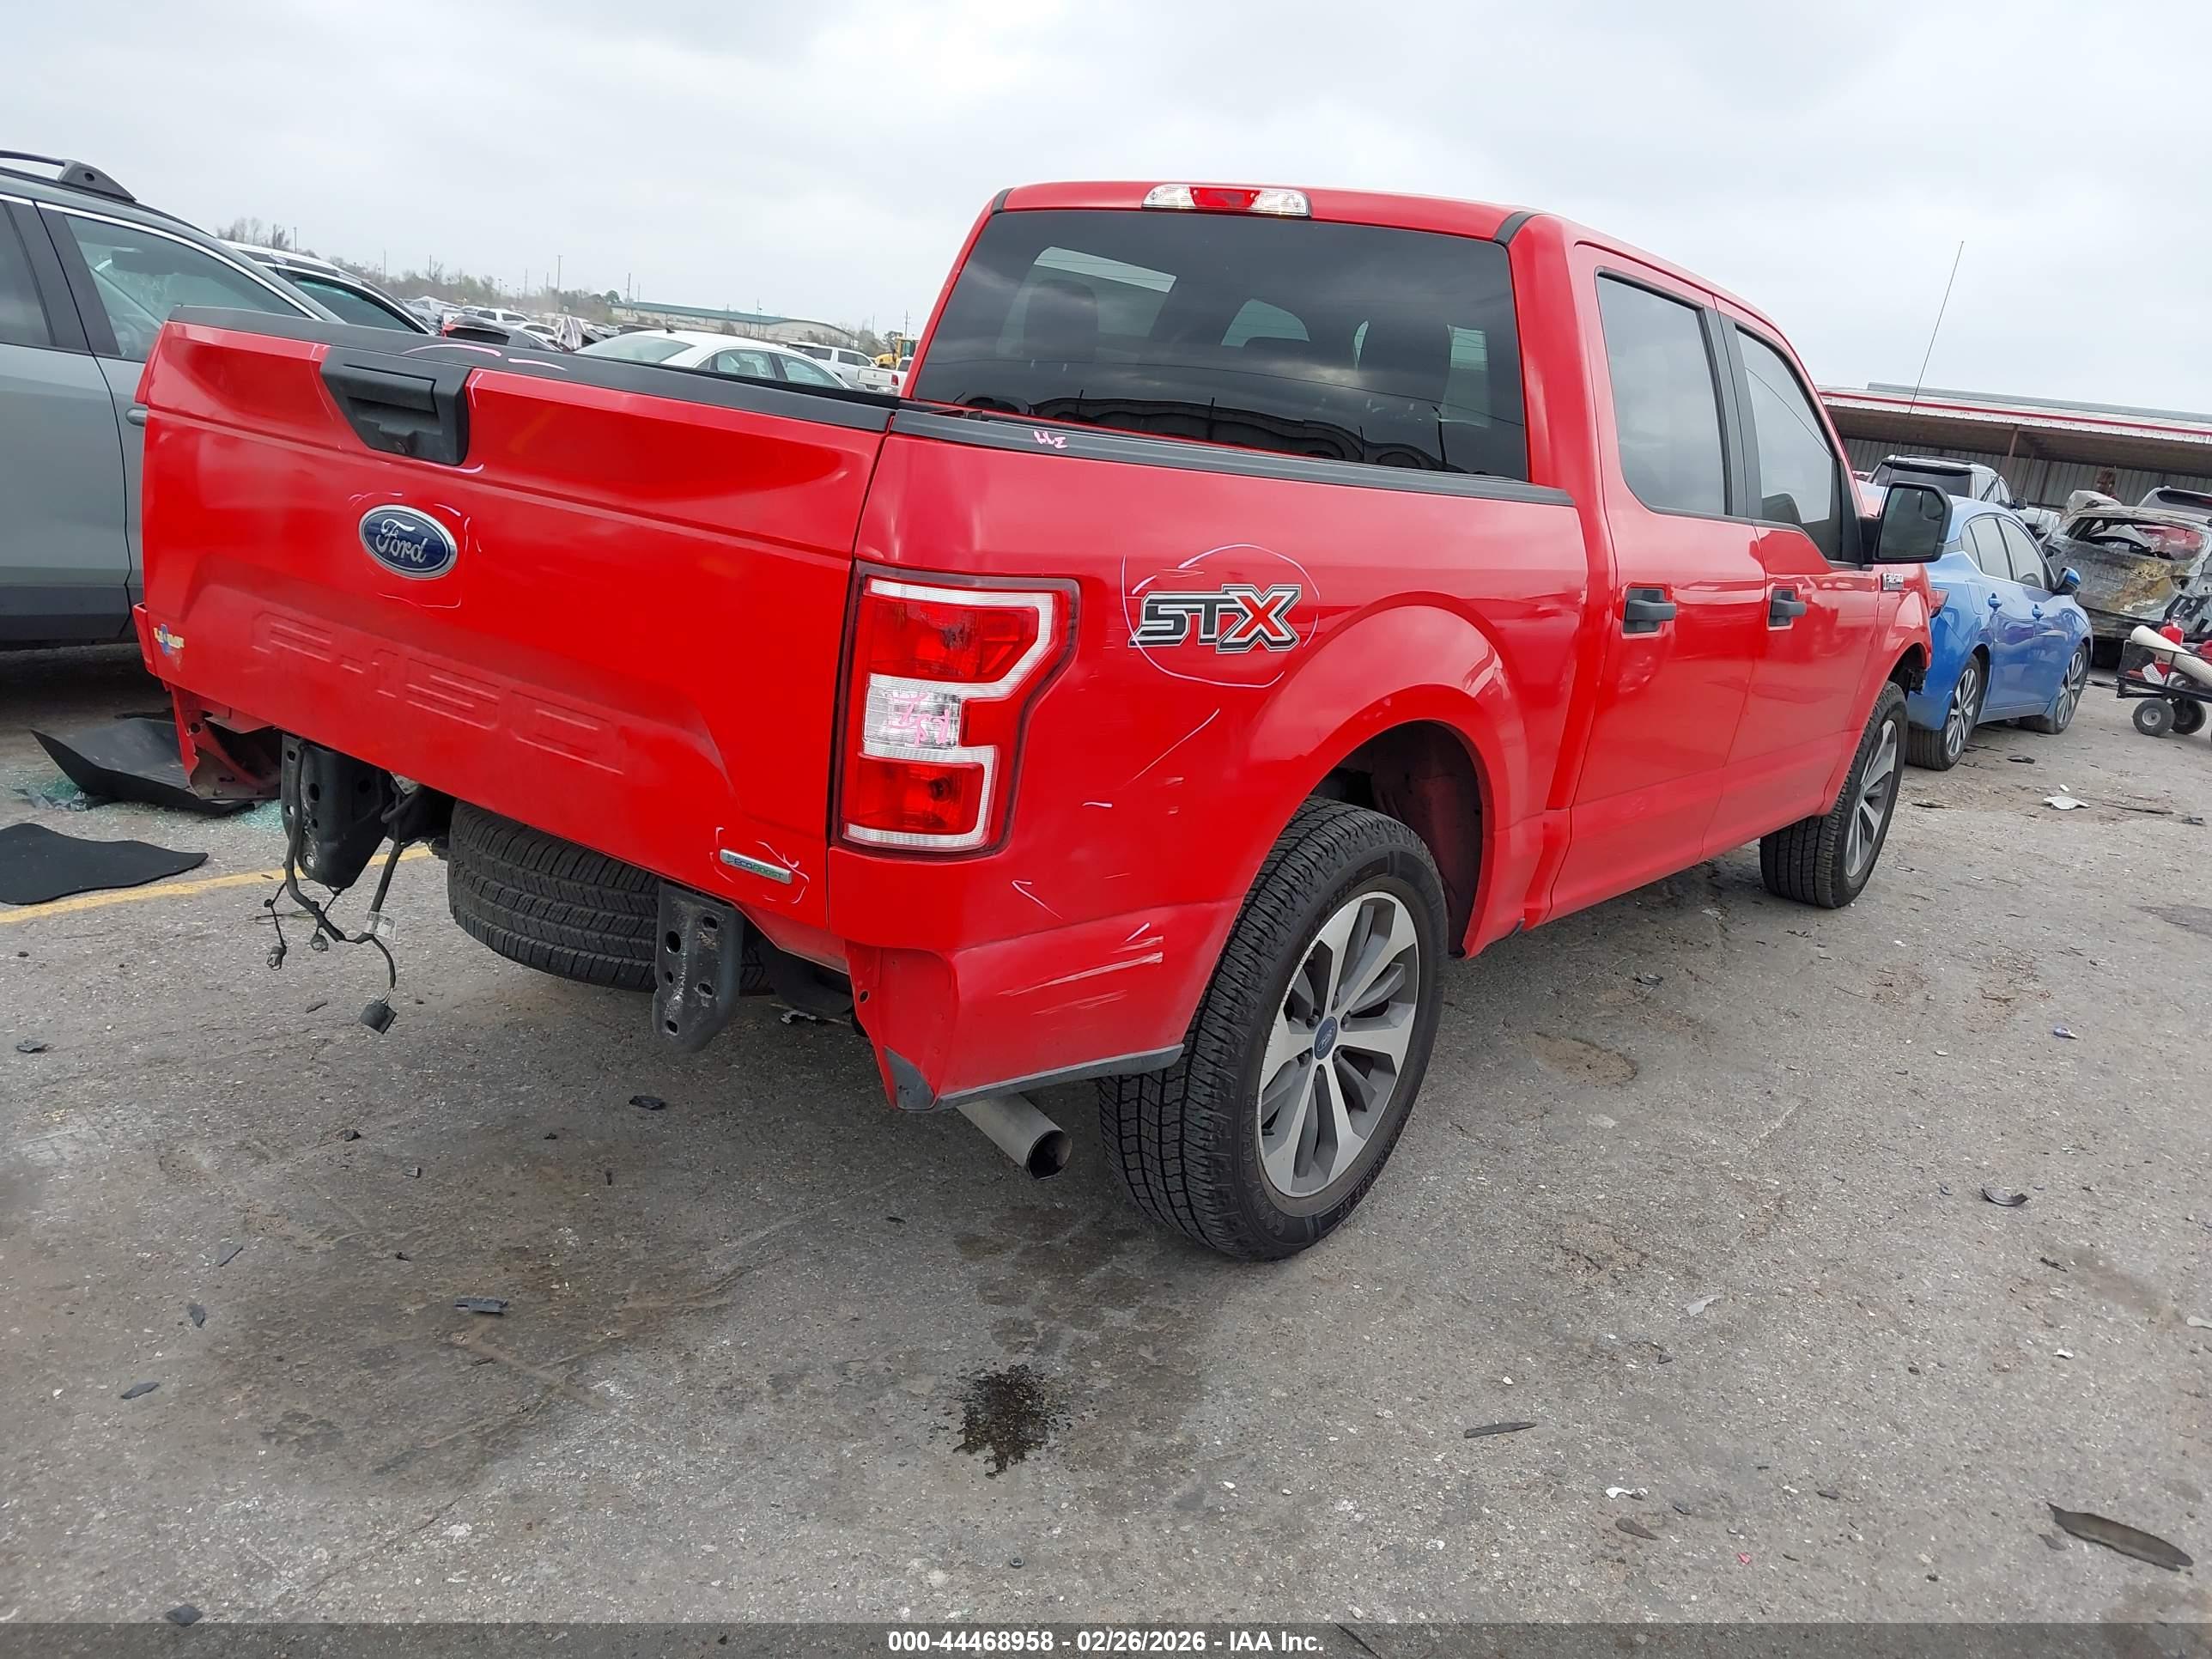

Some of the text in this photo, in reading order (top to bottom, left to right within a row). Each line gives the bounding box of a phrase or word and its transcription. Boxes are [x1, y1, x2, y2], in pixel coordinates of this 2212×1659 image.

[375, 518, 428, 563] Ford
[1127, 583, 1302, 654] STX
[251, 610, 627, 776] F-150
